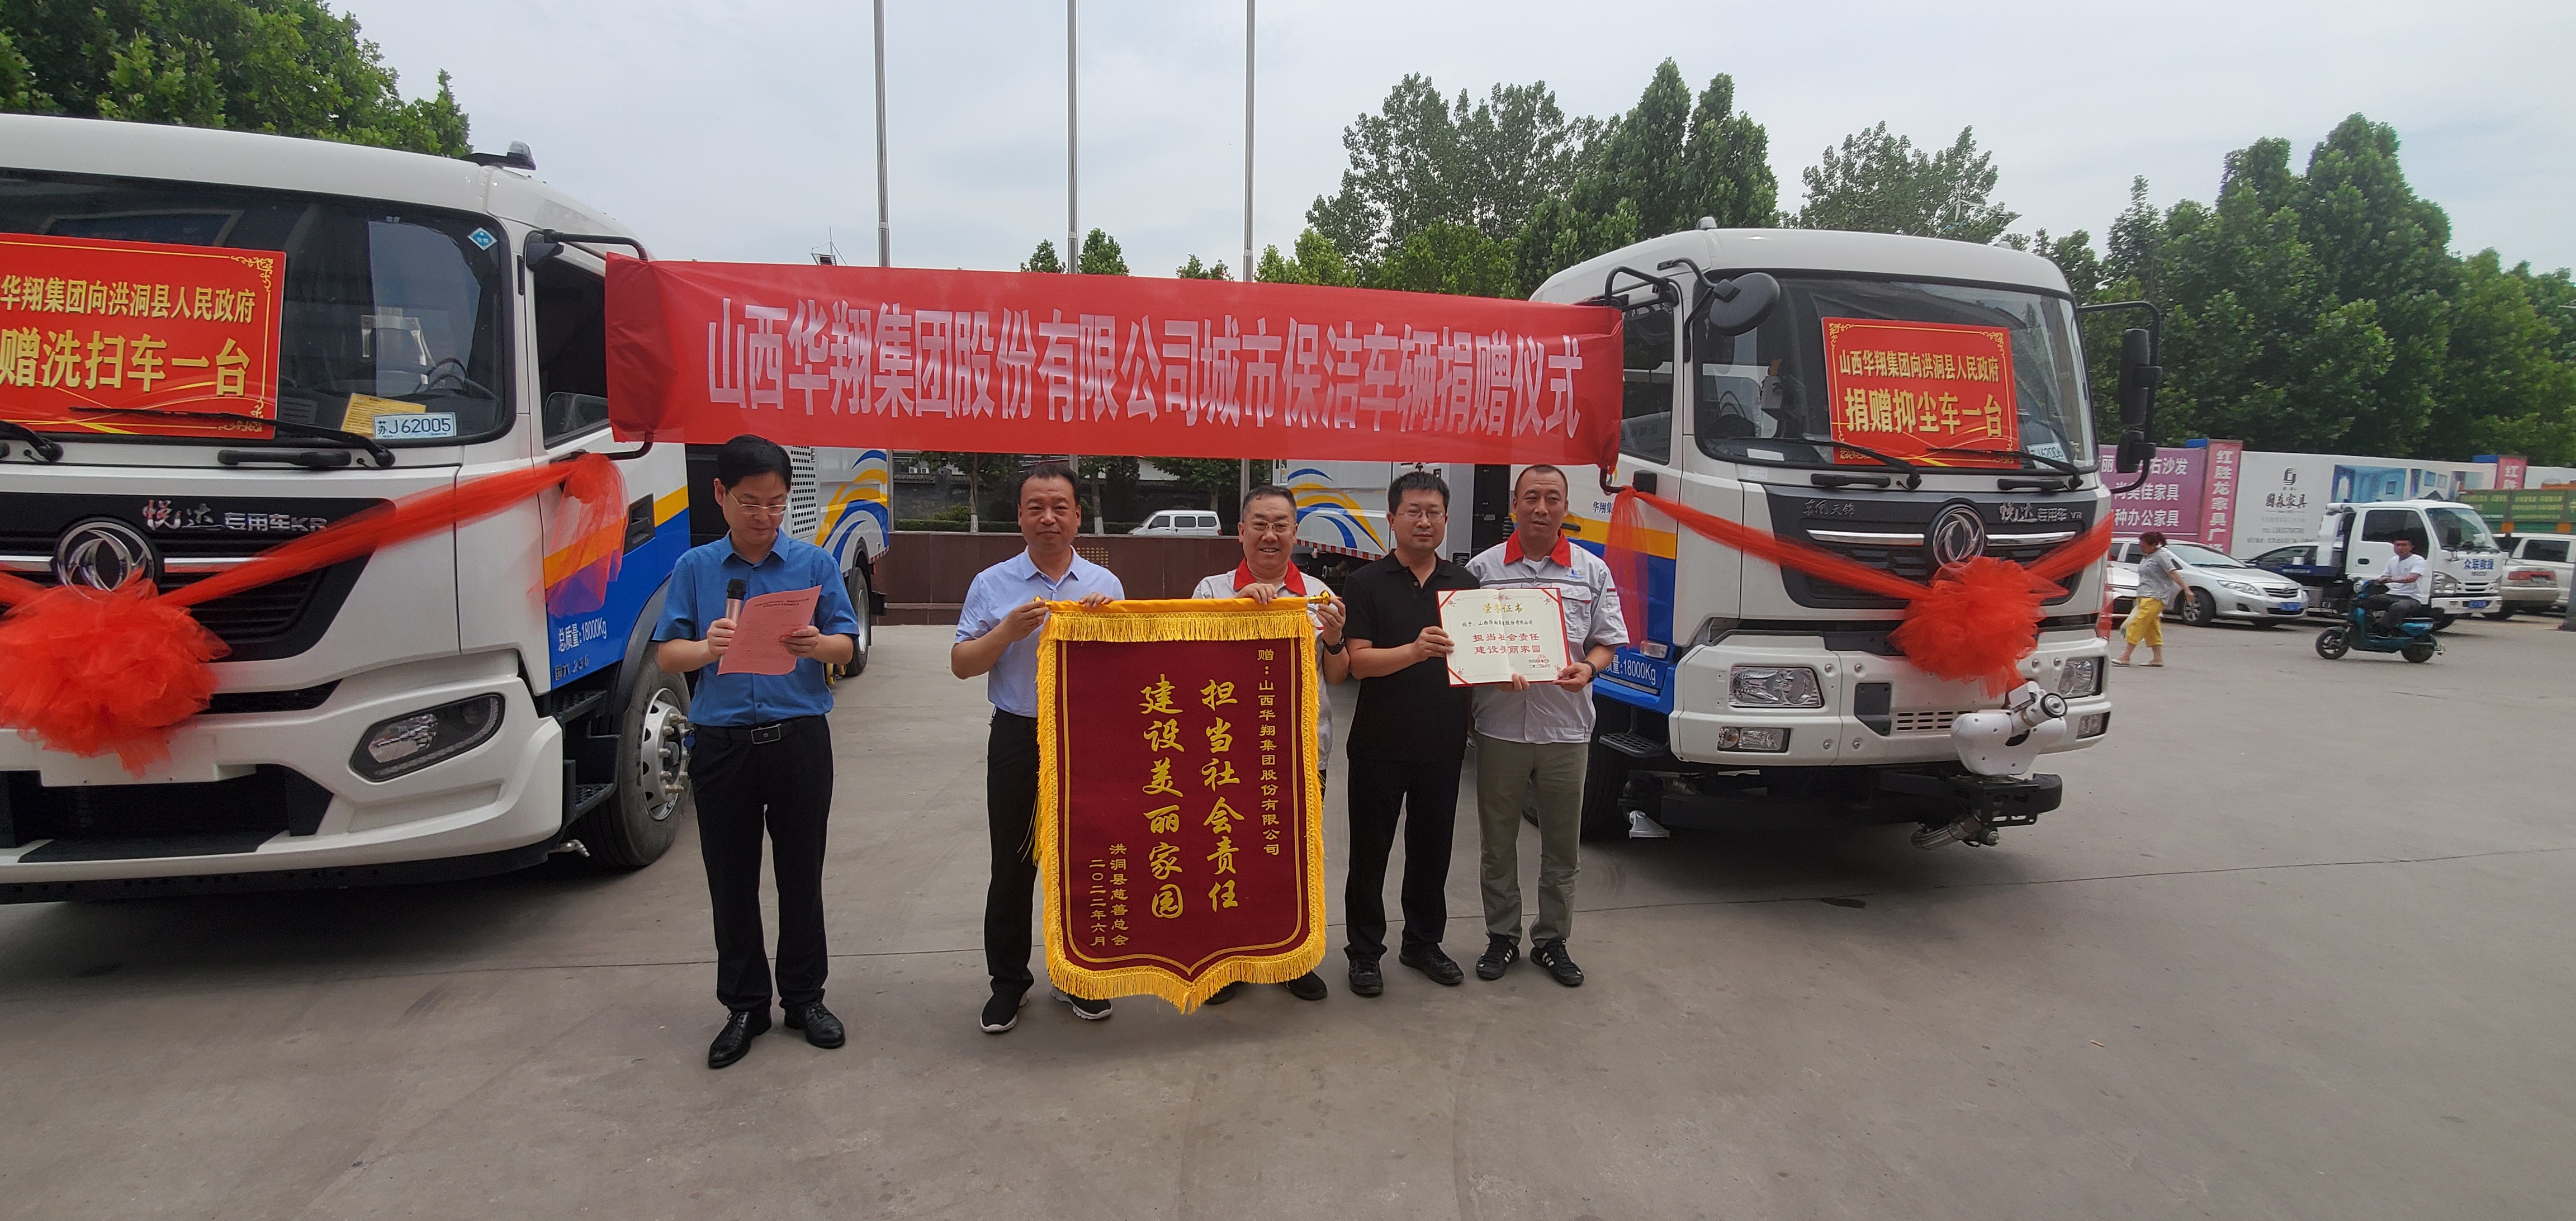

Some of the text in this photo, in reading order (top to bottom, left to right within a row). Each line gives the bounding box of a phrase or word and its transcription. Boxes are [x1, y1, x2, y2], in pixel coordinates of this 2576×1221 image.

[0, 275, 255, 323] 华翔集团向洪洞县人民政府
[0, 326, 250, 396] 赠洗扫车一台
[708, 297, 1583, 439] 山西华翔集团股份有限公司城市保洁车辆捐赠仪式
[1839, 349, 2000, 382] 山西华翔集团向洪洞县人民政府
[377, 418, 451, 435] 苏J62005
[1844, 387, 2003, 437] 捐赠抑尘车一台
[1139, 674, 1184, 919] 建设美丽家园
[1200, 679, 1244, 913] 担当社会责任
[1109, 843, 1129, 946] 洪洞县慈善总会
